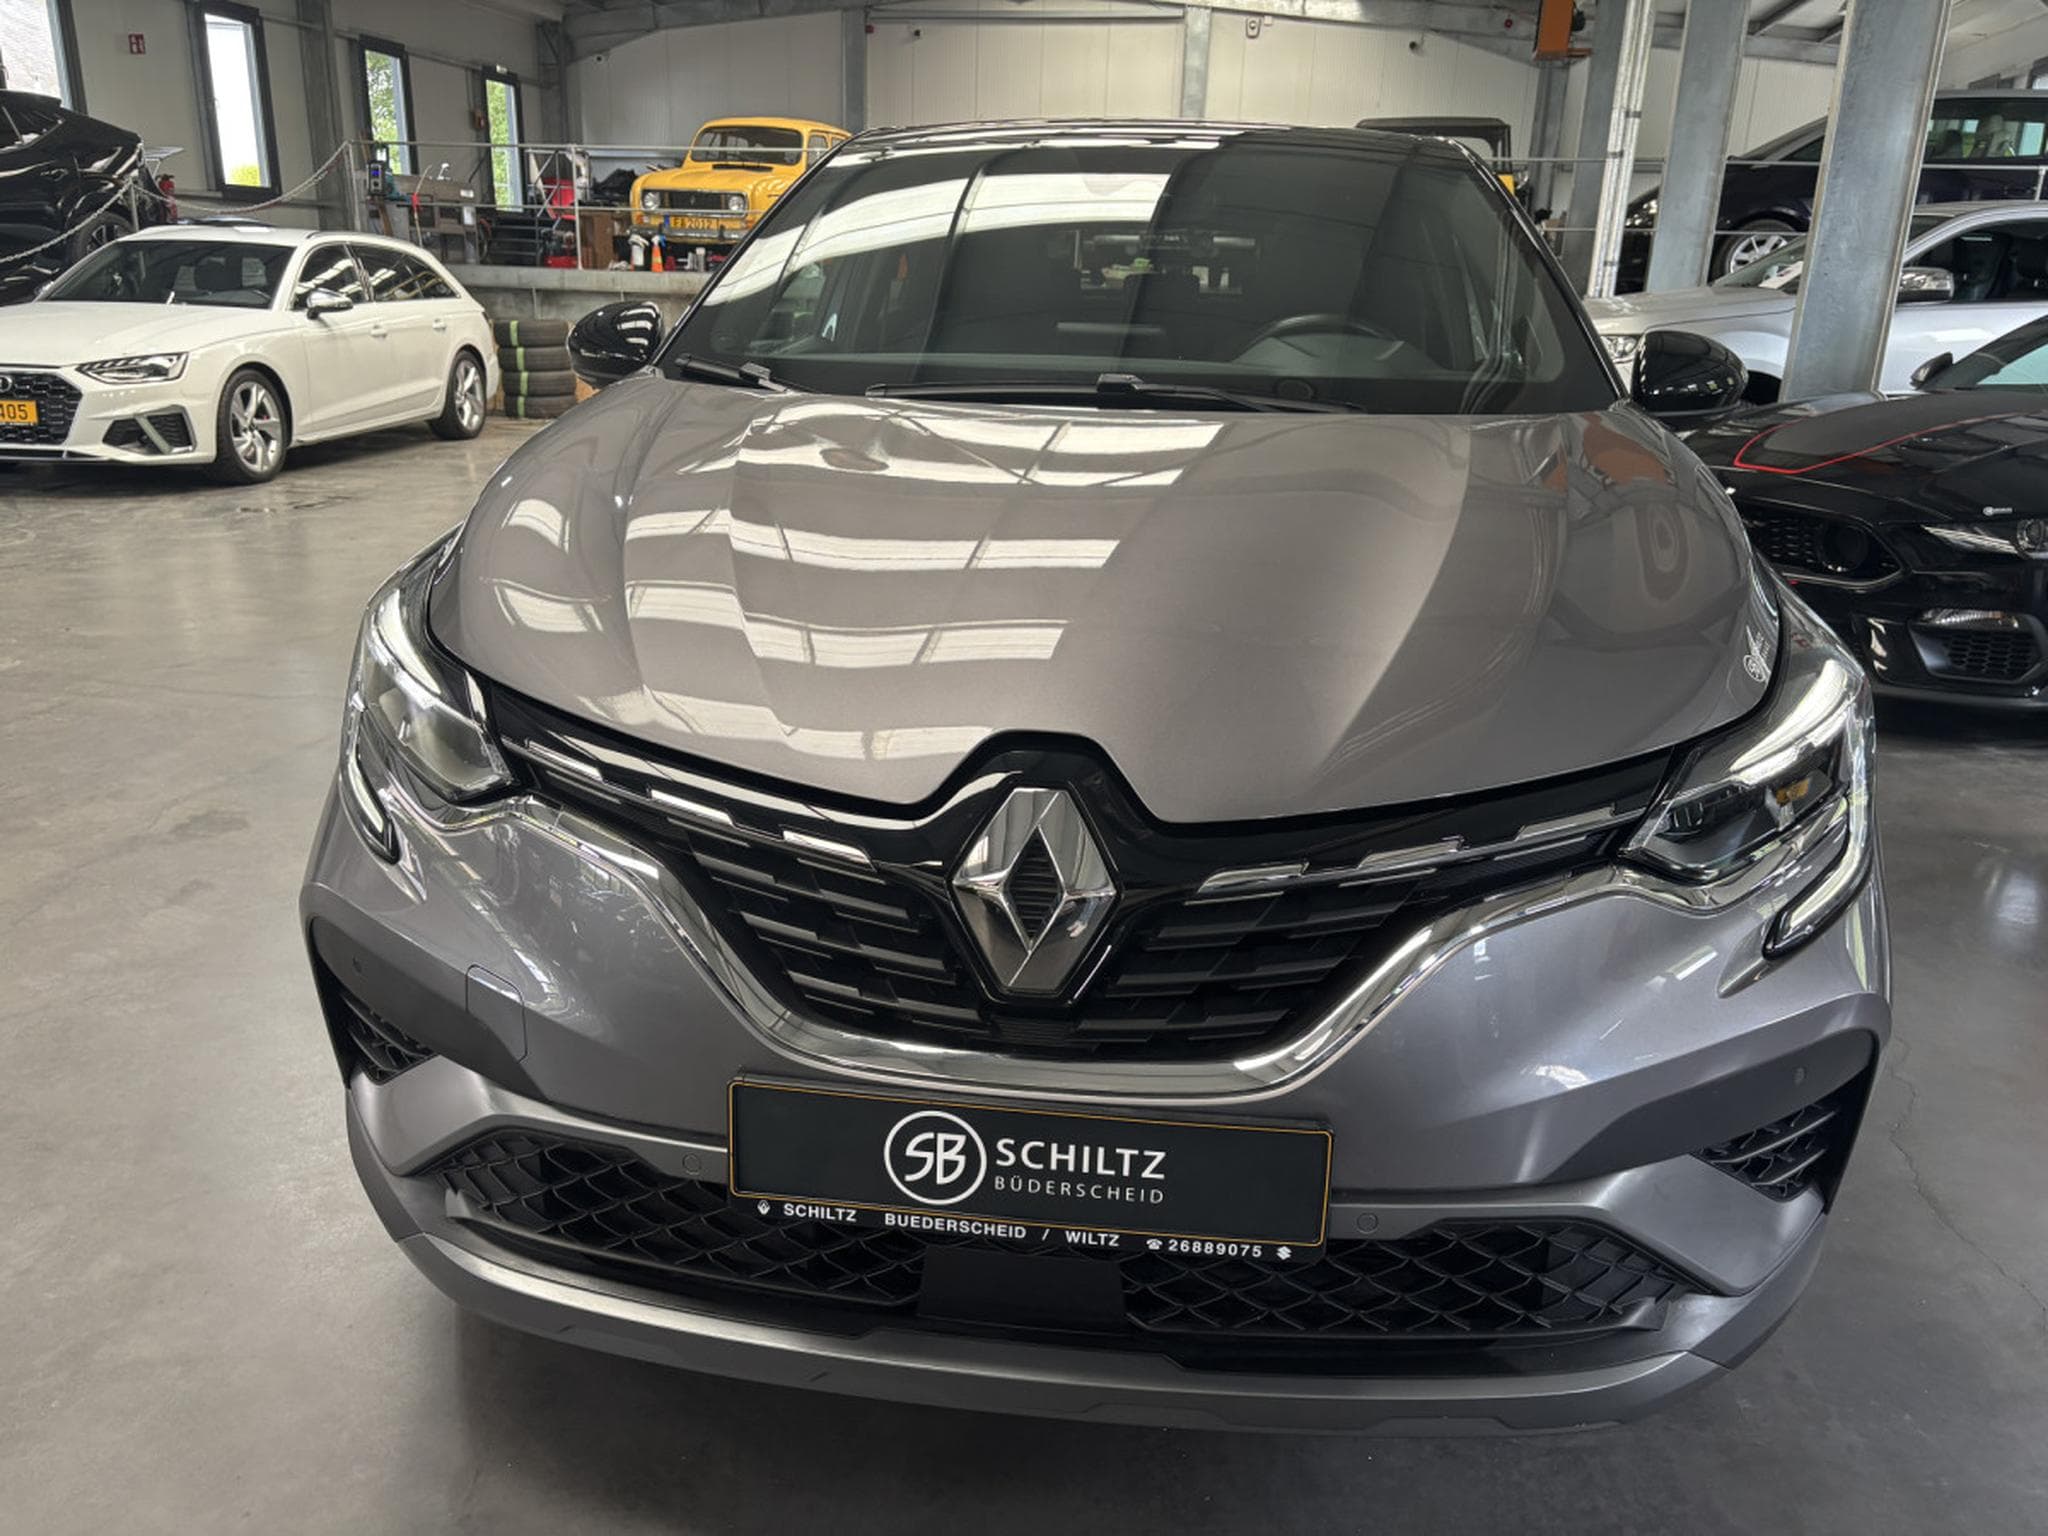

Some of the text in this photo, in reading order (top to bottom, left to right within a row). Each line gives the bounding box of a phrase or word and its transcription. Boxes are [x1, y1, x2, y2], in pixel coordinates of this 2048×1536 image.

[904, 1132, 967, 1185] SB
[995, 1138, 1167, 1180] SCHILTZ
[994, 1175, 1164, 1204] BÜDERSCHEID
[783, 1203, 1263, 1257] SCHILTZ BUEDERSCHEID / WILTZ 26889075
